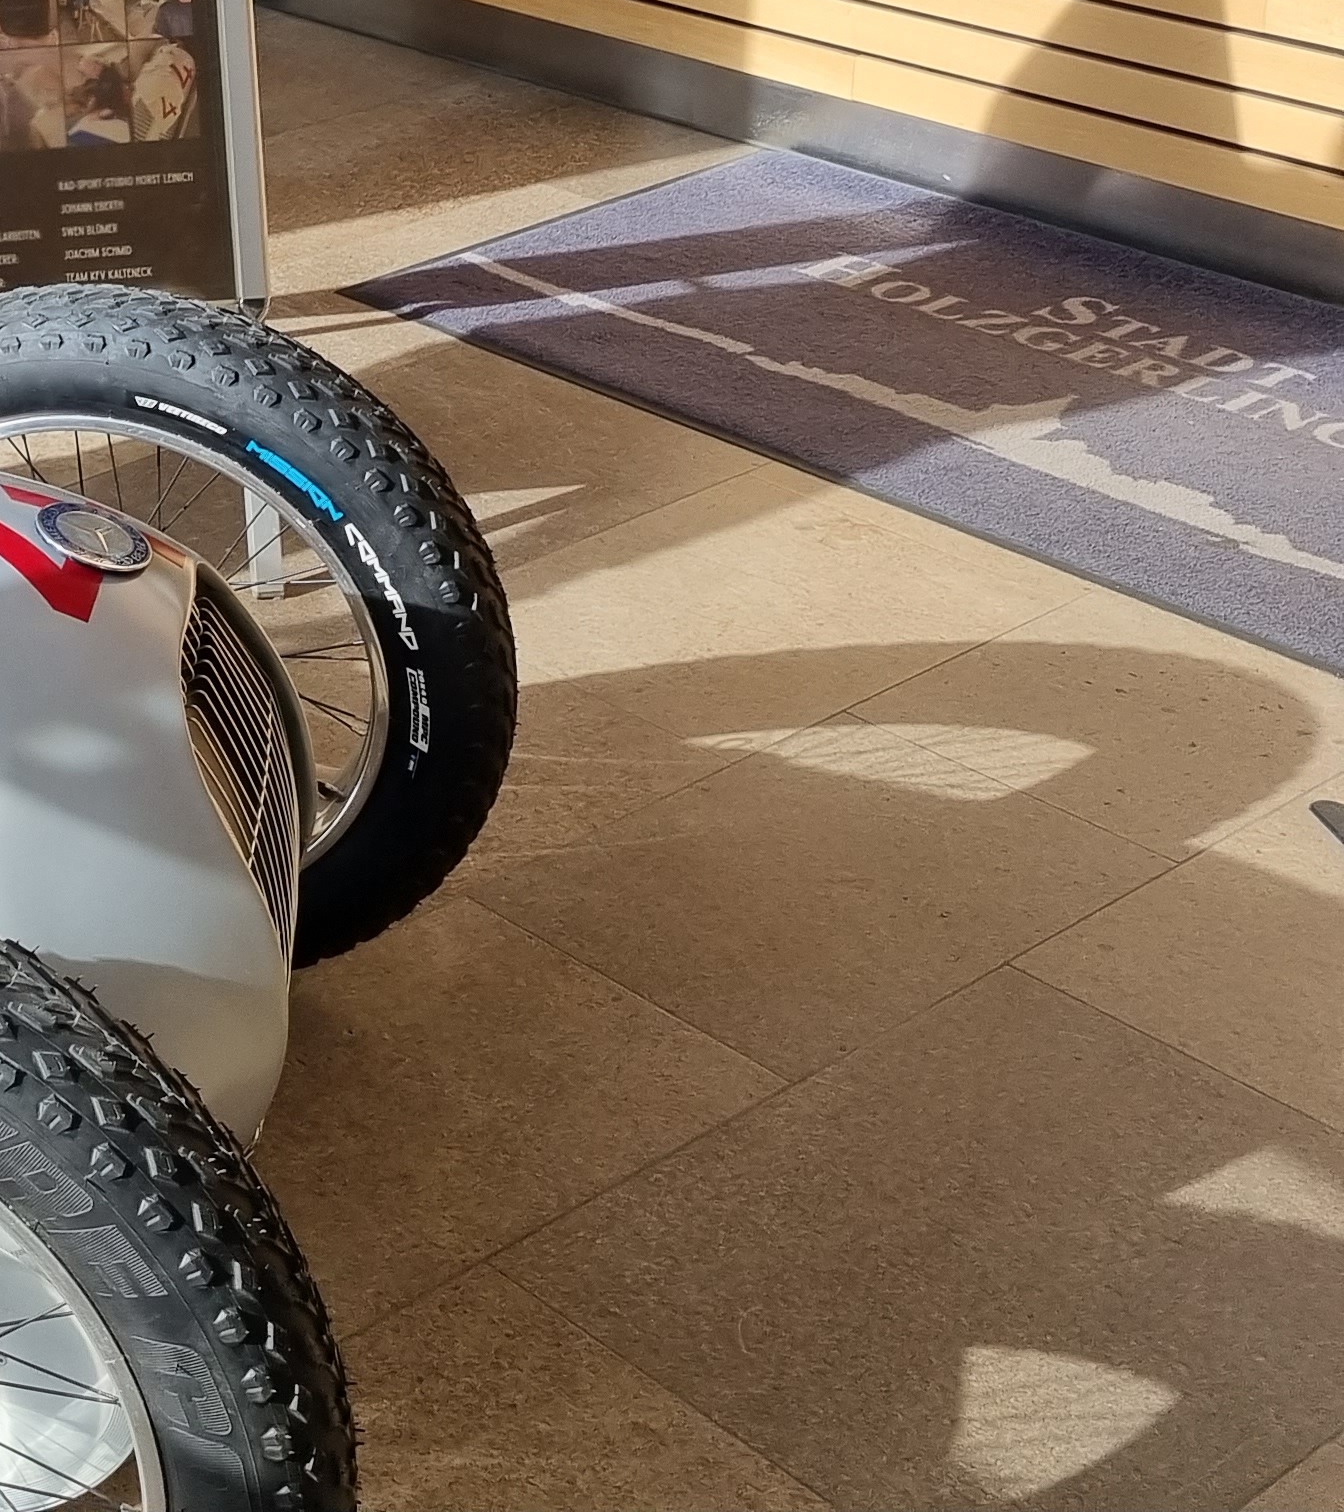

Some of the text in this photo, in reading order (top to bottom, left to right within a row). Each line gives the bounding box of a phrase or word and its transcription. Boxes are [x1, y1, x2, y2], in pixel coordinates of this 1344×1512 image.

[1031, 295, 1317, 389] STADT
[245, 439, 344, 521] MISSION
[344, 522, 419, 650] COMMAND
